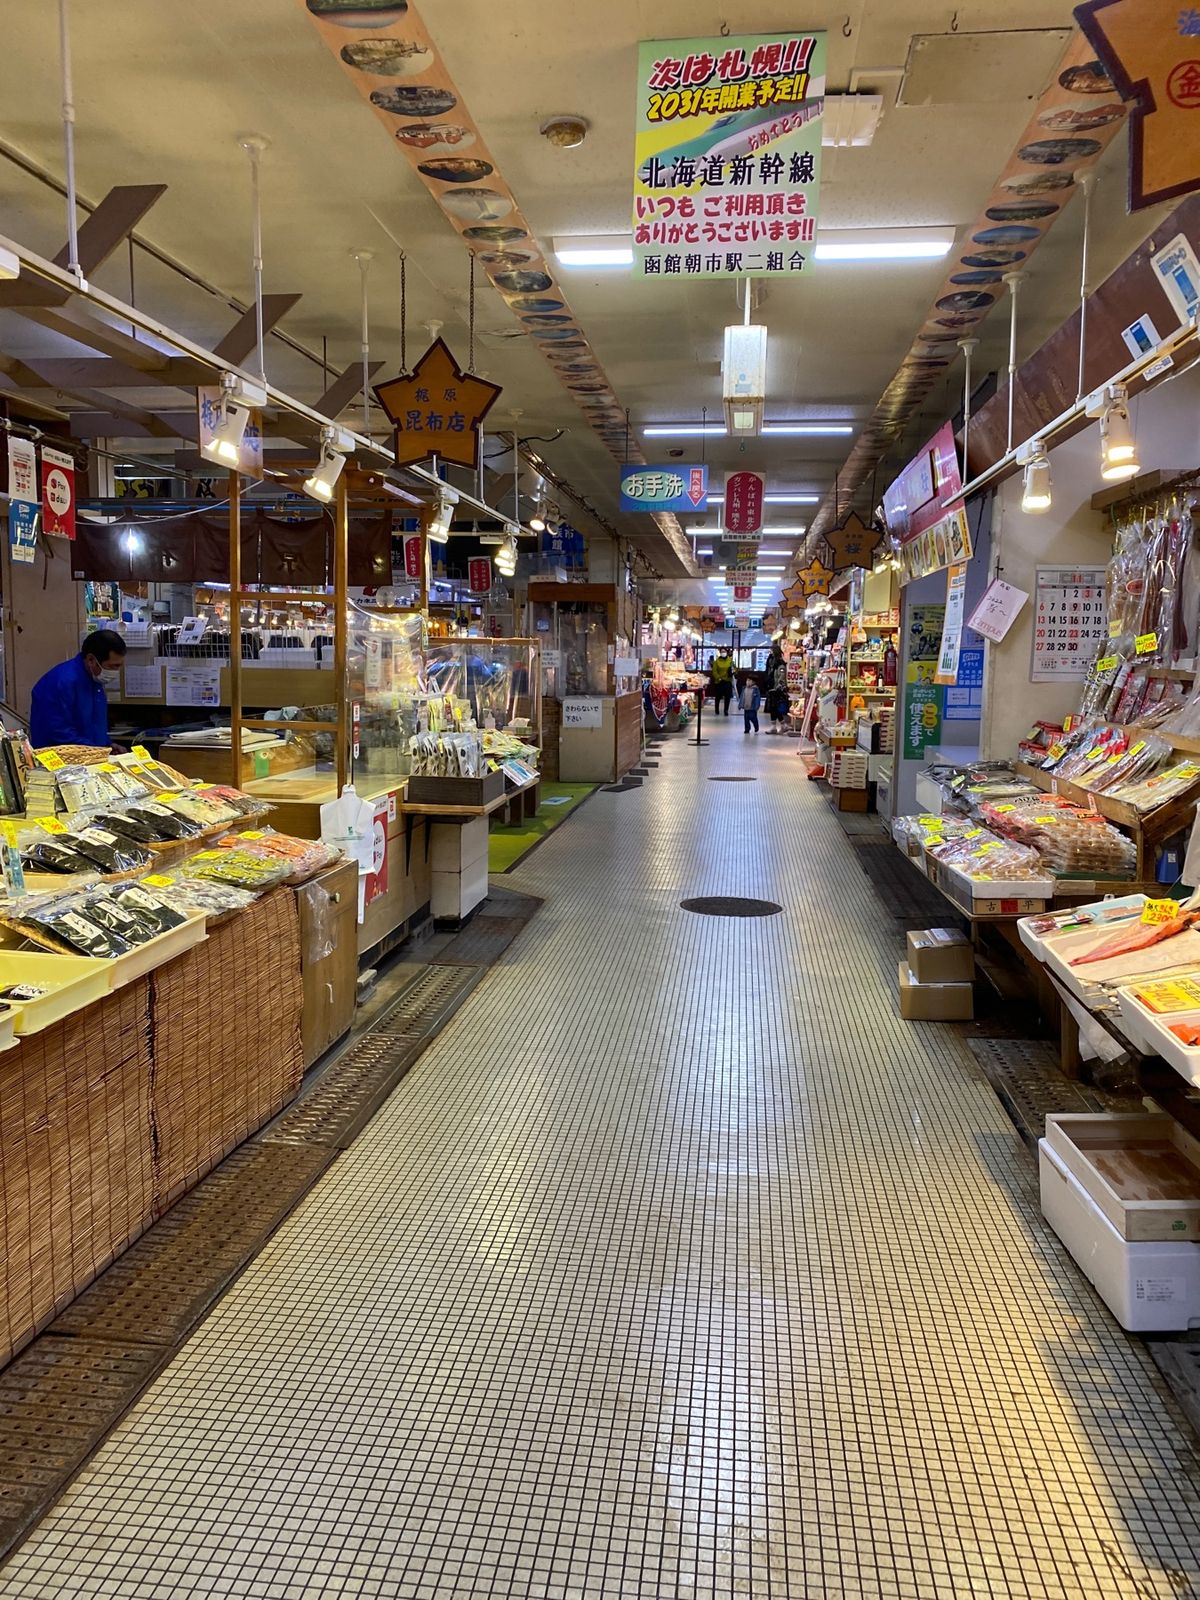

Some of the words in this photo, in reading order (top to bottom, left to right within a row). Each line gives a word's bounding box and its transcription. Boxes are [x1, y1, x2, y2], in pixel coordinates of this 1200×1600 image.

[648, 37, 816, 89] 次は札幌!!
[647, 73, 809, 121] 2031年開業予定!!
[641, 151, 815, 188] 北海道新幹線
[636, 196, 696, 218] いつも
[703, 193, 806, 217] ご利用頂き
[634, 219, 814, 245] ありがとうございます!!
[644, 250, 806, 275] 函館朝市駅二組合
[406, 410, 465, 432] 昆布店
[627, 473, 683, 497] お手洗
[1073, 590, 1079, 598] 2
[1084, 590, 1090, 598] 3
[1096, 590, 1102, 598] 4
[1039, 603, 1045, 611] 6
[1050, 603, 1055, 611] 7
[1061, 603, 1067, 611] 8
[1072, 603, 1078, 611] 9
[1082, 603, 1091, 611] 10
[1094, 603, 1102, 611] 11
[974, 617, 1005, 636] Campus
[1048, 617, 1056, 625] 14
[1093, 617, 1101, 625] 18
[1037, 630, 1045, 638] 20
[1048, 630, 1055, 638] 21
[1058, 630, 1067, 638] 22
[1069, 630, 1078, 638] 23
[1081, 630, 1089, 638] 24
[1092, 630, 1101, 638] 25
[1036, 643, 1044, 651] 27
[1046, 643, 1055, 651] 28
[1057, 643, 1066, 651] 29
[1067, 643, 1078, 651] 30
[909, 703, 924, 747] 使えます
[986, 902, 997, 912] 古
